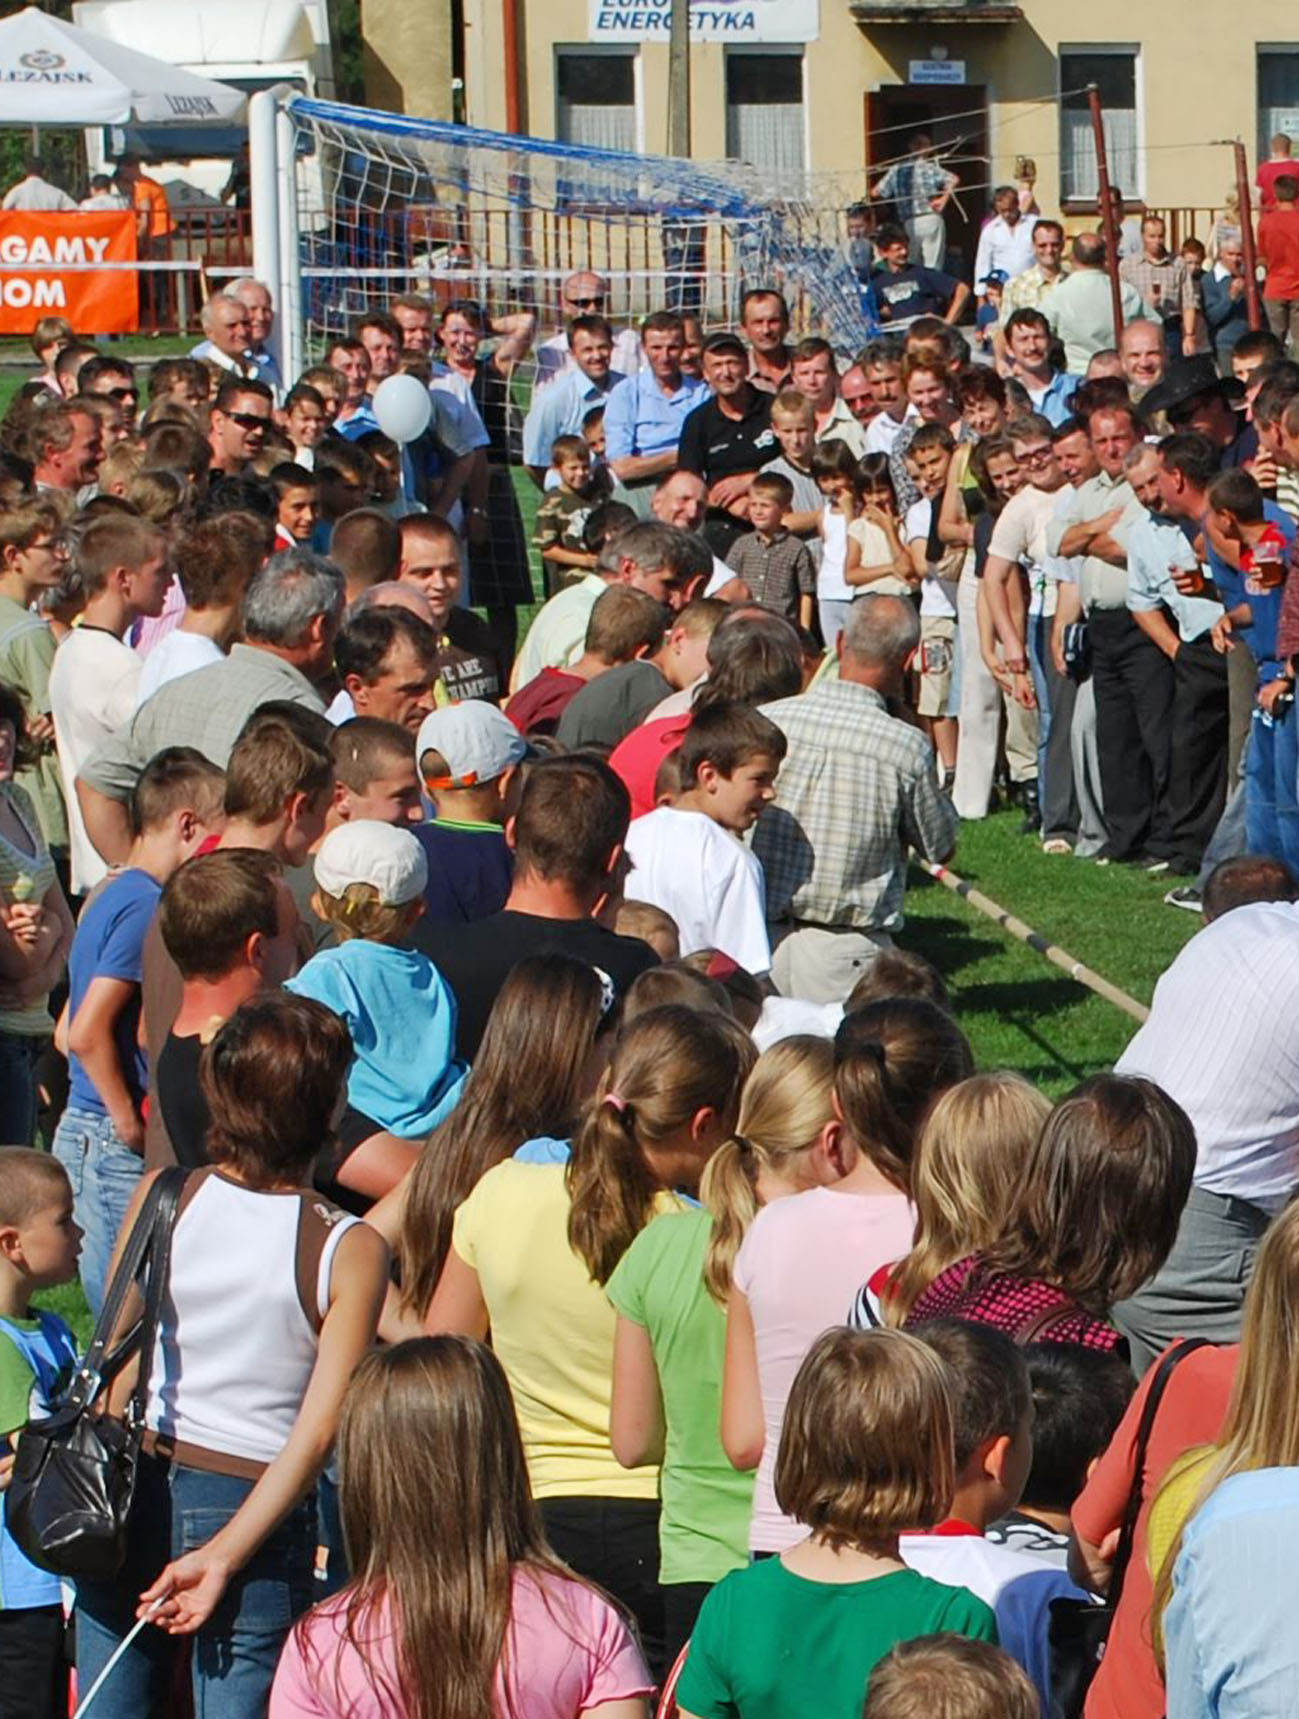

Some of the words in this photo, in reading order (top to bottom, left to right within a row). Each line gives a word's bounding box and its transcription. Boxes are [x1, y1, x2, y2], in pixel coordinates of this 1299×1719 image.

[597, 11, 755, 29] ENERGTYKA
[0, 278, 67, 308] OM
[456, 658, 483, 679] ARE
